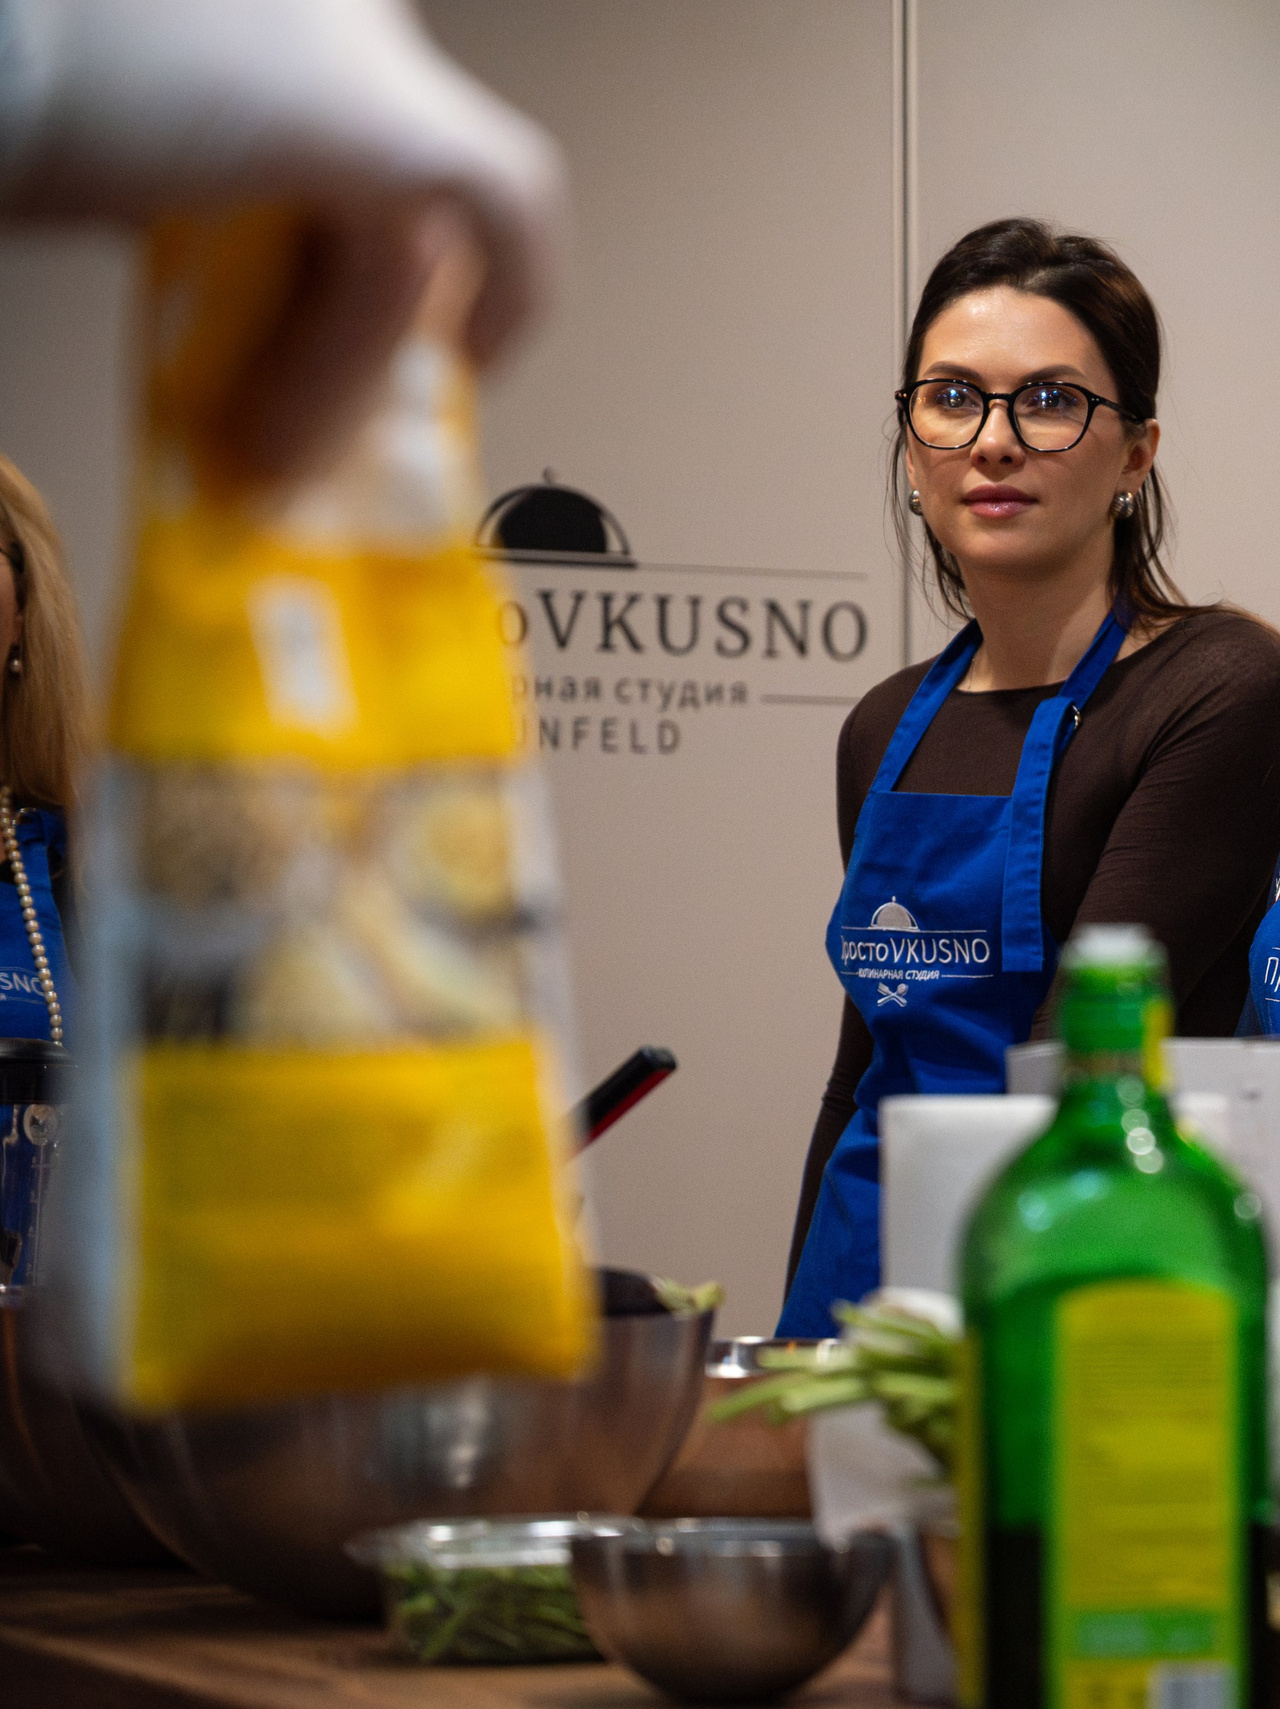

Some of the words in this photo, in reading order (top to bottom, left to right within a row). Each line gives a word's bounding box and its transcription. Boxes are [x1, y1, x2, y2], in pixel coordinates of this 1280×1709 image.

[614, 677, 749, 713] студия
[522, 715, 681, 755] NFELD
[905, 969, 940, 981] СТУДИЯ
